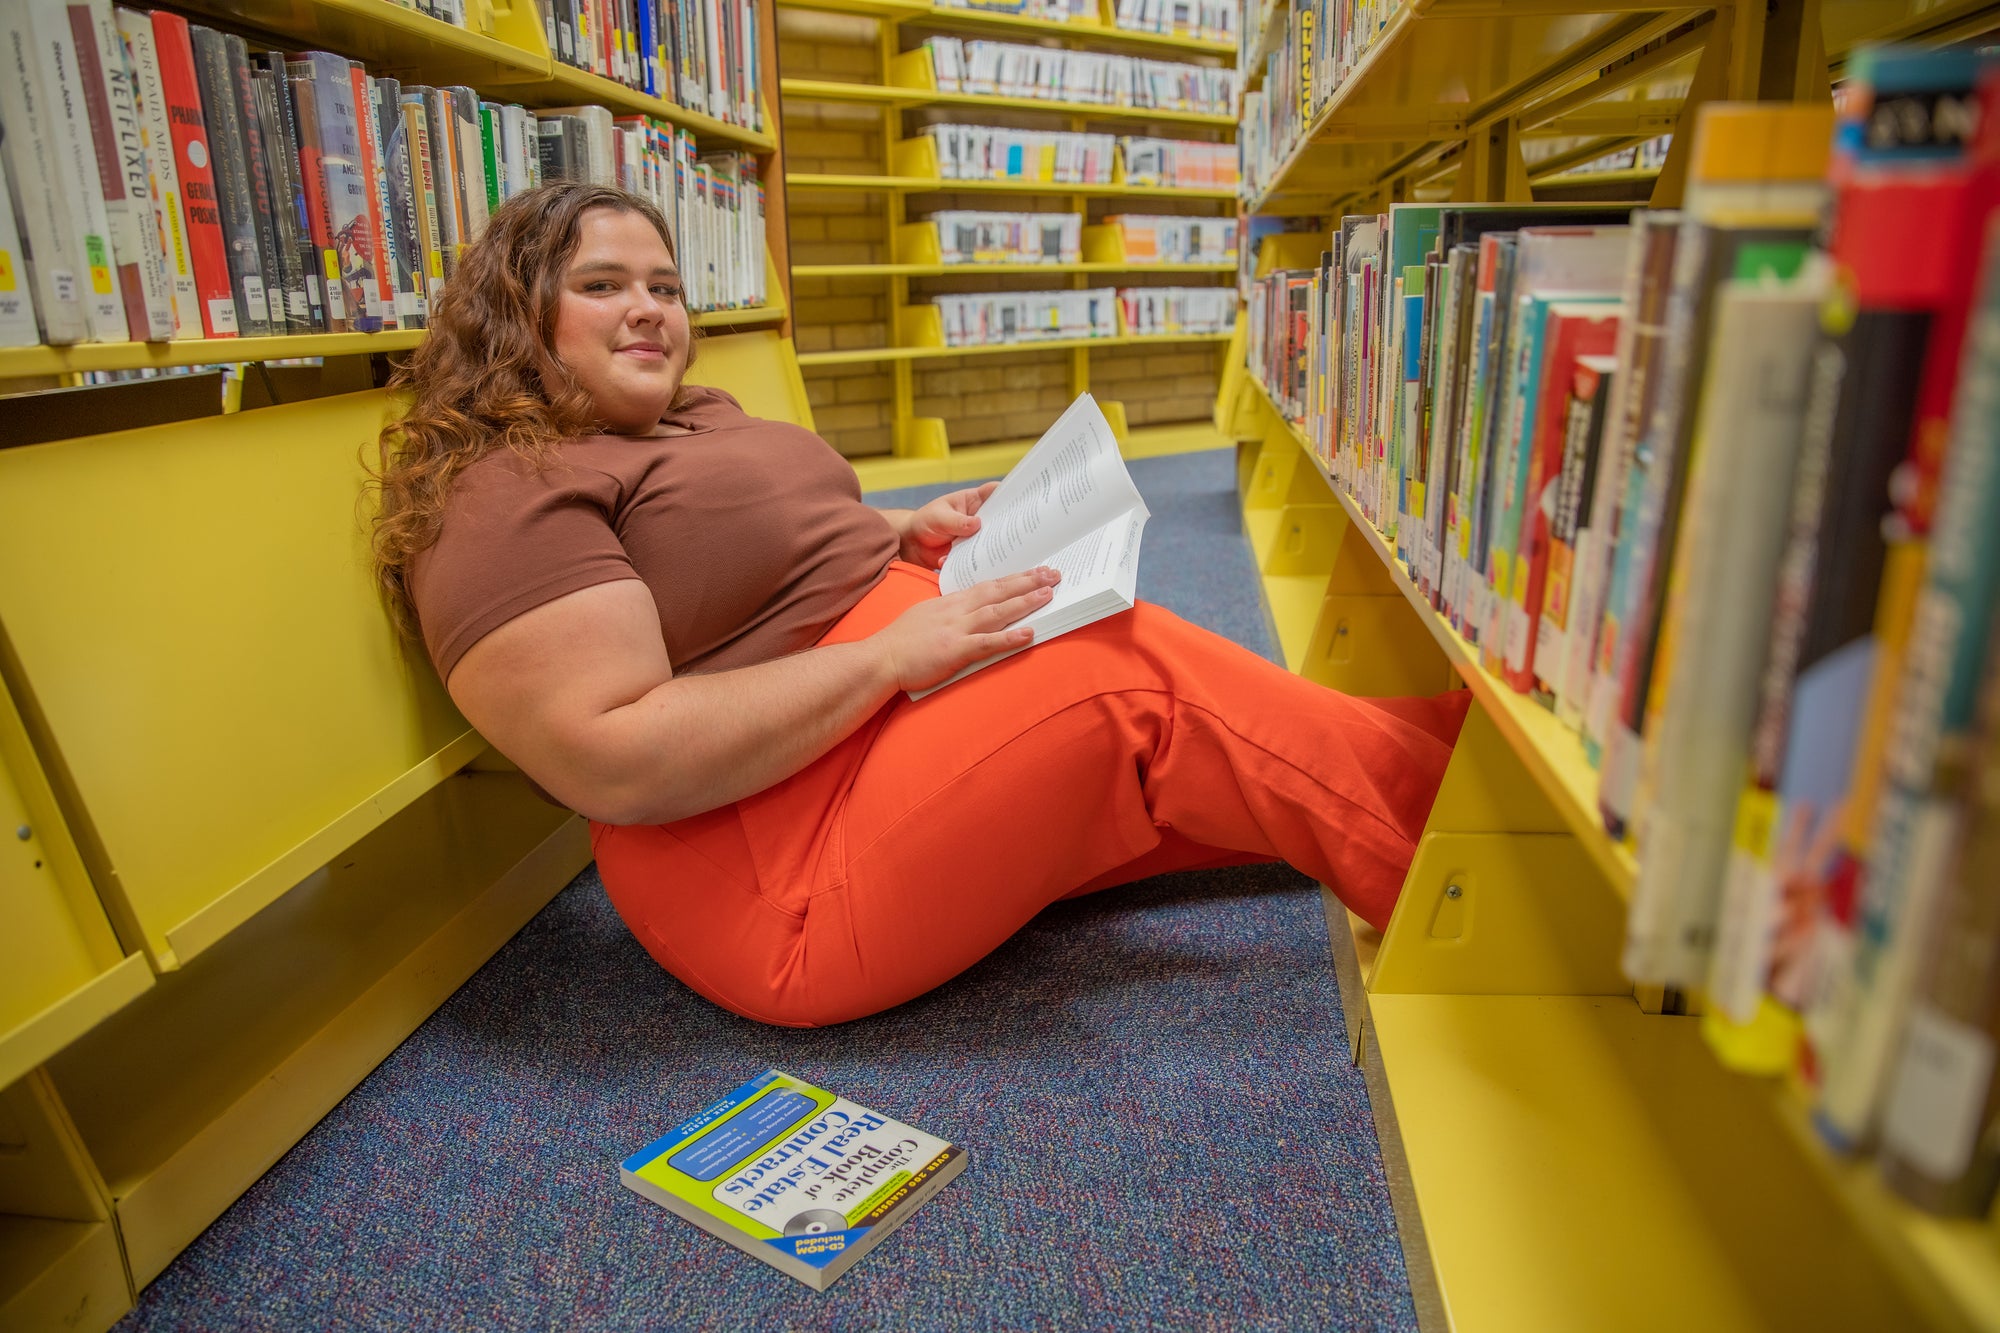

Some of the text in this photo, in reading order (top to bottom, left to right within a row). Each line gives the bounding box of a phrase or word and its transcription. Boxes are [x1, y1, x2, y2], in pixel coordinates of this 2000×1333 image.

[138, 33, 153, 70] OUR
[52, 40, 66, 81] Steve
[61, 84, 74, 119] Jobs
[208, 69, 218, 92] Secret
[145, 77, 162, 123] DAILY
[212, 95, 224, 129] History
[335, 103, 347, 115] THE
[359, 82, 368, 108] FULL
[364, 114, 374, 149] MONEY
[368, 89, 378, 120] LEILA
[109, 68, 148, 199] NETFLIXED
[218, 49, 239, 138] EMPIRE
[238, 171, 253, 225] PAIN
[281, 72, 301, 176] SOLAR REVOLUTION
[155, 131, 171, 182] MEDS
[270, 83, 293, 208] STORY OF MY PEOPLE
[417, 129, 434, 191] ELON MUSK
[223, 156, 234, 190] Sackler
[399, 143, 412, 188] ELON
[459, 171, 467, 191] APPLE
[229, 191, 238, 225] Dynasty
[315, 156, 335, 240] Chocolate
[405, 190, 418, 241] MUSK
[371, 159, 392, 286] TRACY KIDDER
[380, 180, 397, 260] GIVE WORK
[428, 207, 438, 228] QUEST
[138, 212, 150, 257] America's
[146, 260, 158, 298] Eyeballs
[681, 1100, 737, 1136] MARK WARDA
[681, 1121, 694, 1131] Law
[702, 1099, 728, 1117] Attorney
[748, 1109, 766, 1121] Forms
[756, 1104, 802, 1138] Money Saving Tips
[757, 1100, 794, 1126] Selling Advice
[686, 1131, 733, 1162] Alternate Clauses
[699, 1135, 742, 1164] Buyer's Position
[724, 1111, 851, 1195] Contracts
[729, 1140, 752, 1158] Required
[820, 1112, 888, 1158] Real
[822, 1144, 884, 1184] Book
[832, 1139, 919, 1202] Complete
[890, 1156, 912, 1171] The
[743, 1155, 833, 1212] Estate
[804, 1184, 822, 1201] of
[871, 1153, 950, 1218] OVER 200 CLAUSES
[795, 1234, 845, 1247] Included
[796, 1241, 845, 1255] CD-ROM
